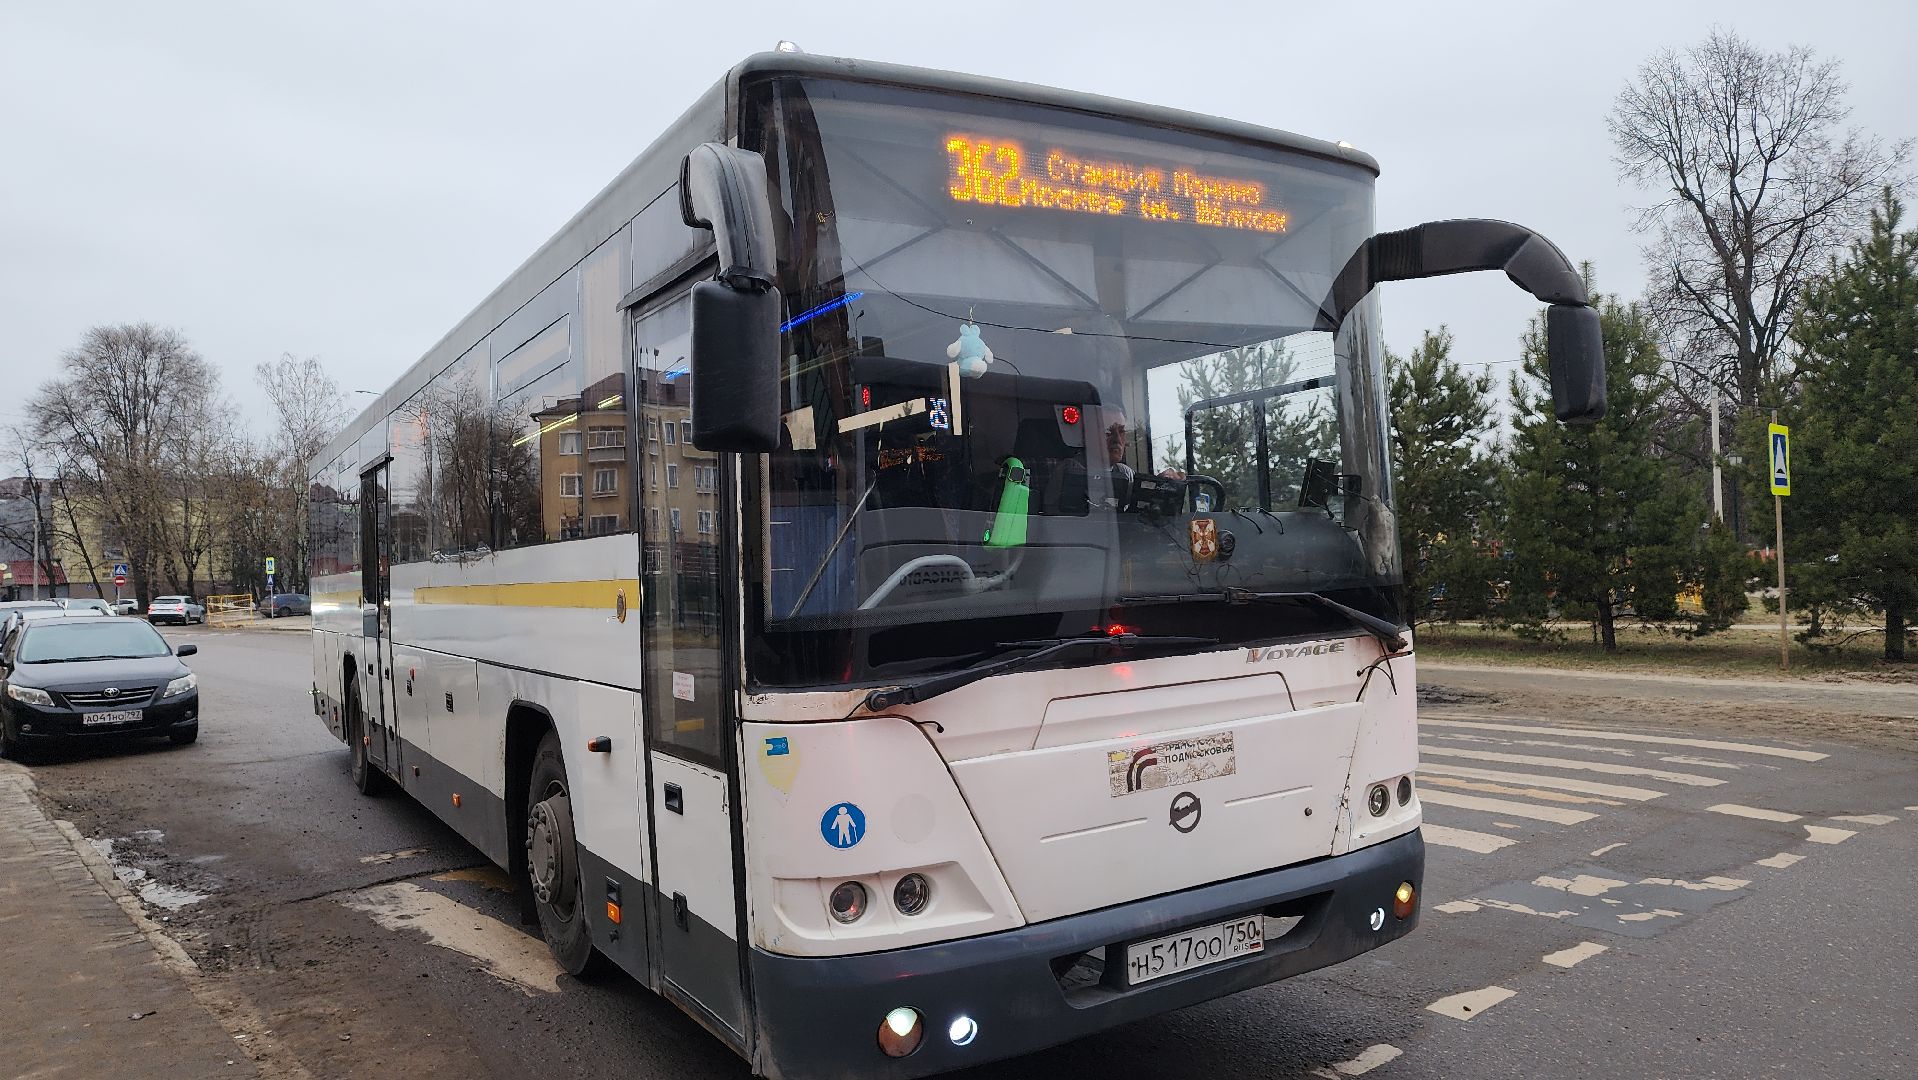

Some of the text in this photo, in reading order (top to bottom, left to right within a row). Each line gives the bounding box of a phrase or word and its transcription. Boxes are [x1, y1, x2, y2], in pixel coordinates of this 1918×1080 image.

[946, 139, 1020, 206] 362
[1048, 153, 1260, 205] Станция Монино
[1021, 178, 1125, 215] Москва
[1246, 642, 1344, 664] VOYAGE
[1164, 744, 1234, 764] ПОДМОСКОВЬЯ
[1226, 920, 1257, 946] 750
